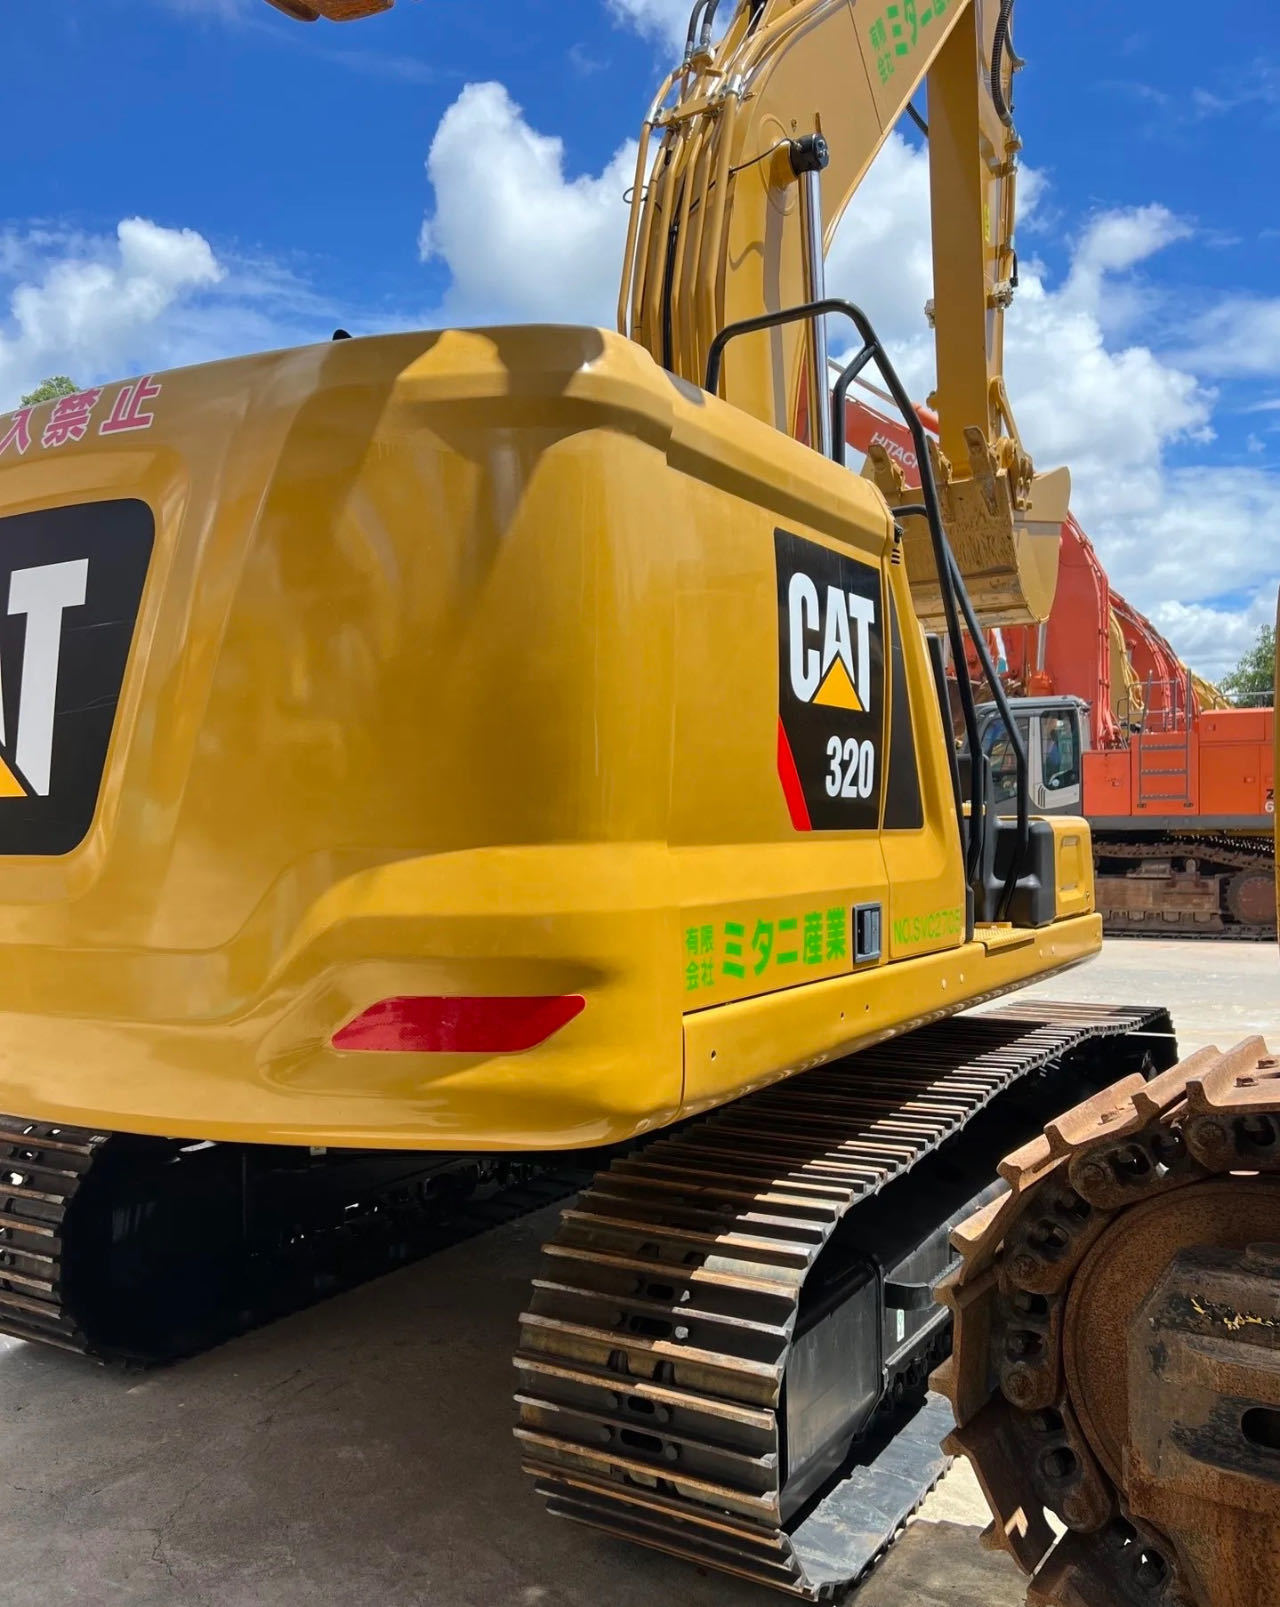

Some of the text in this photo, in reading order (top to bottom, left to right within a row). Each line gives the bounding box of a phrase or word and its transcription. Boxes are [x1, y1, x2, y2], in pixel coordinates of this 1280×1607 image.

[0, 375, 162, 456] 入禁止
[788, 571, 875, 713] CAT
[825, 735, 875, 799] 320
[722, 906, 846, 979] ミタニ産業
